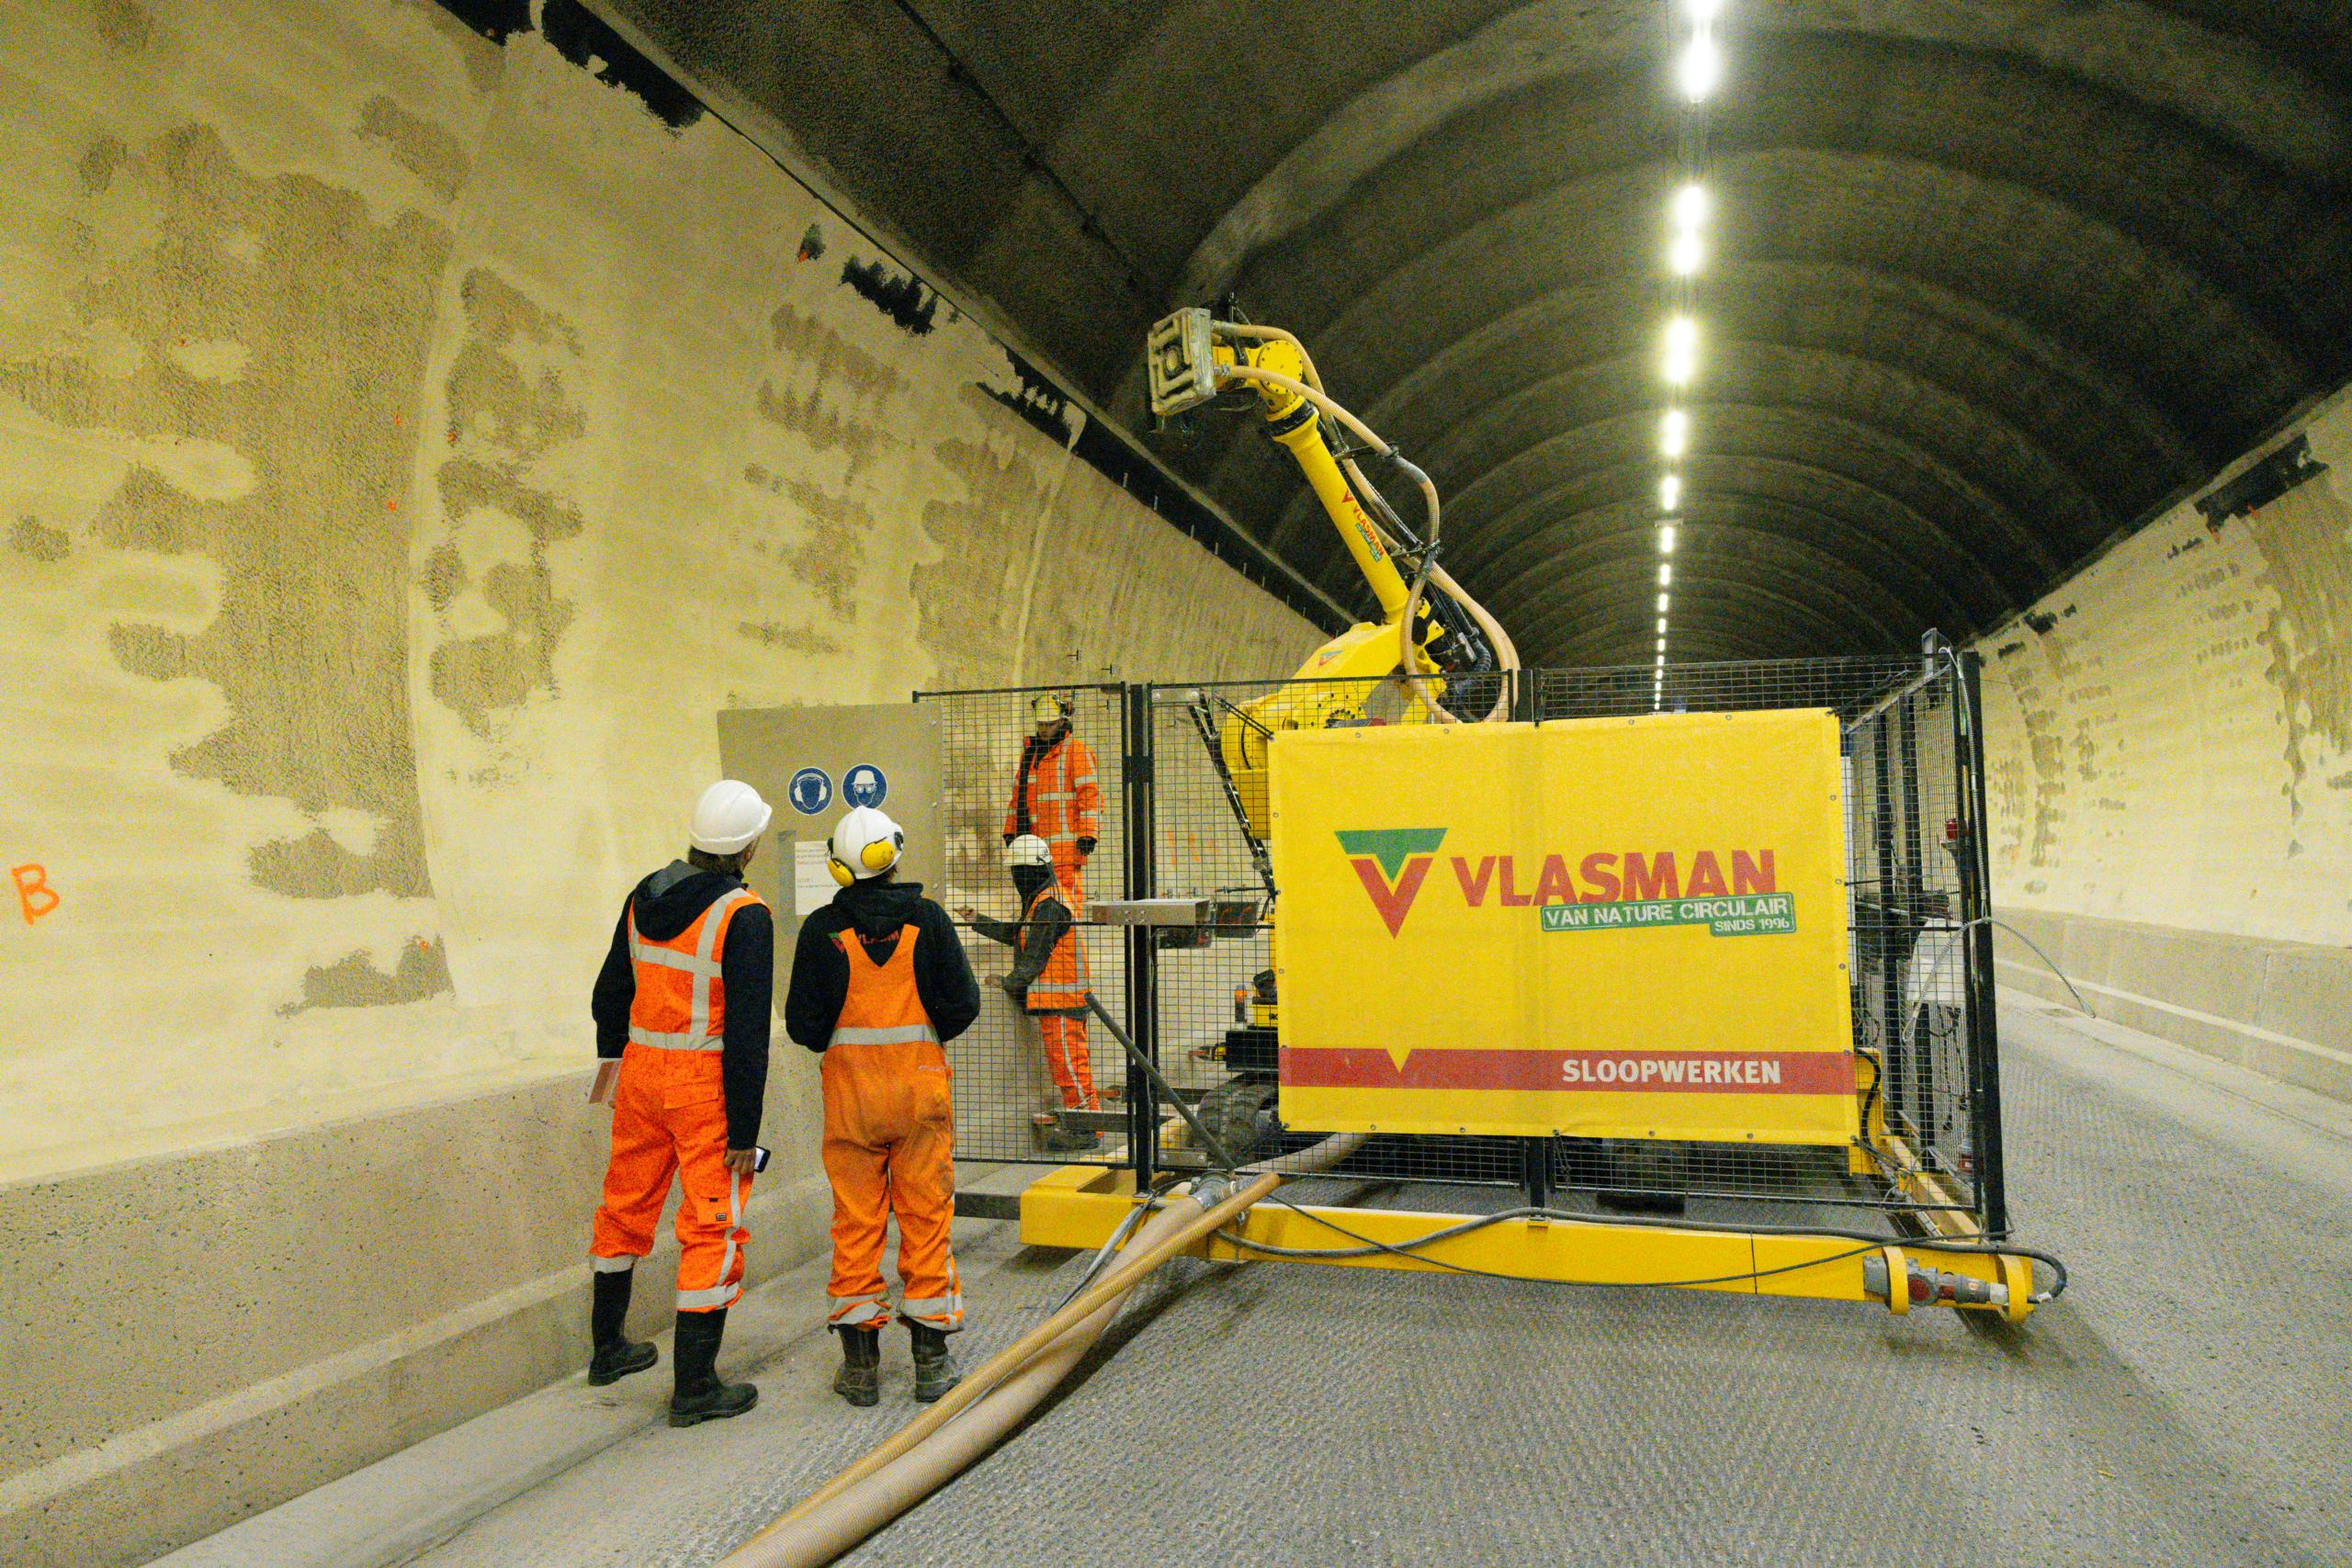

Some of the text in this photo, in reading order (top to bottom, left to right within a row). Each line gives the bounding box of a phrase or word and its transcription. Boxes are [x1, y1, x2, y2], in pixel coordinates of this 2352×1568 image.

[1450, 849, 1777, 907] VLASMAN
[11, 863, 60, 926] B
[1544, 897, 1788, 927] VAN NATURE CIRCULAIR
[1714, 917, 1790, 932] SINDS 1996
[1562, 1059, 1781, 1084] SLOOPWERKEN
